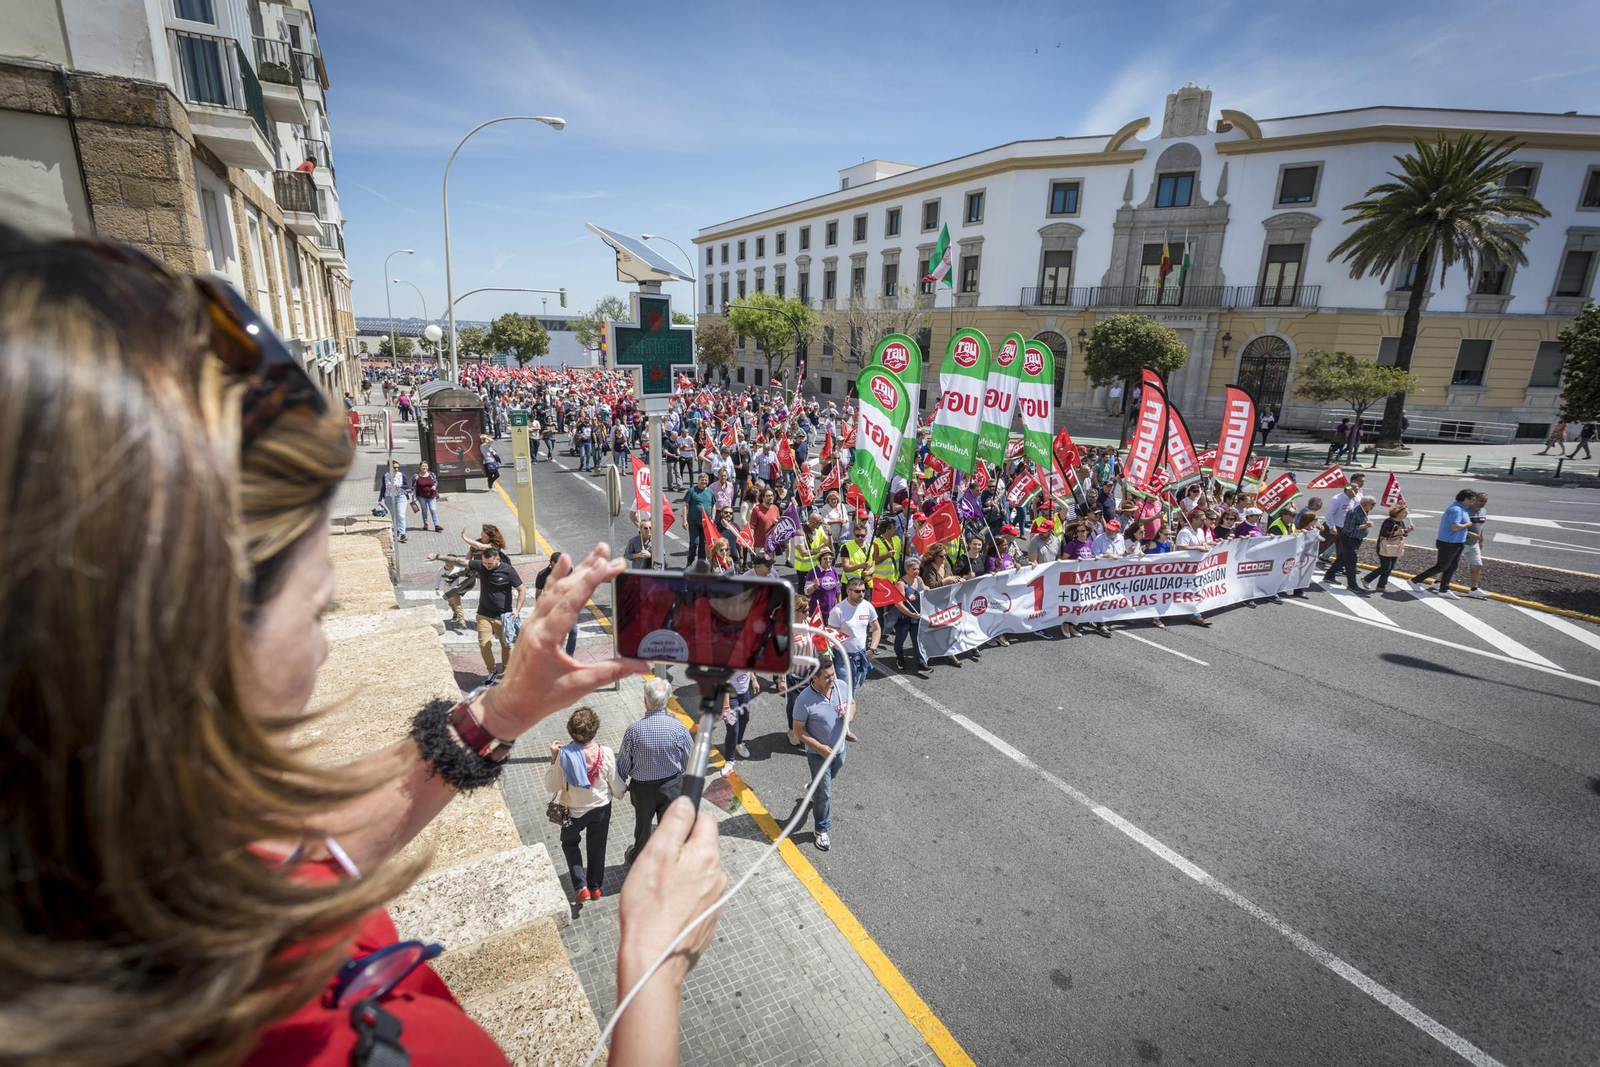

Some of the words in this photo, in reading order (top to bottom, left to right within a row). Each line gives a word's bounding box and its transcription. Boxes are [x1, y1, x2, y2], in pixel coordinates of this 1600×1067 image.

[1096, 563, 1147, 580] LUCHA
[1239, 563, 1264, 573] CCOO
[1027, 575, 1044, 612] 1
[1058, 597, 1129, 617] PRIMERO
[1131, 593, 1158, 607] LAS
[1162, 583, 1228, 604] PERSONAS
[972, 599, 986, 609] UGT
[931, 610, 957, 626] CCOO
[1028, 611, 1047, 621] MAYO
